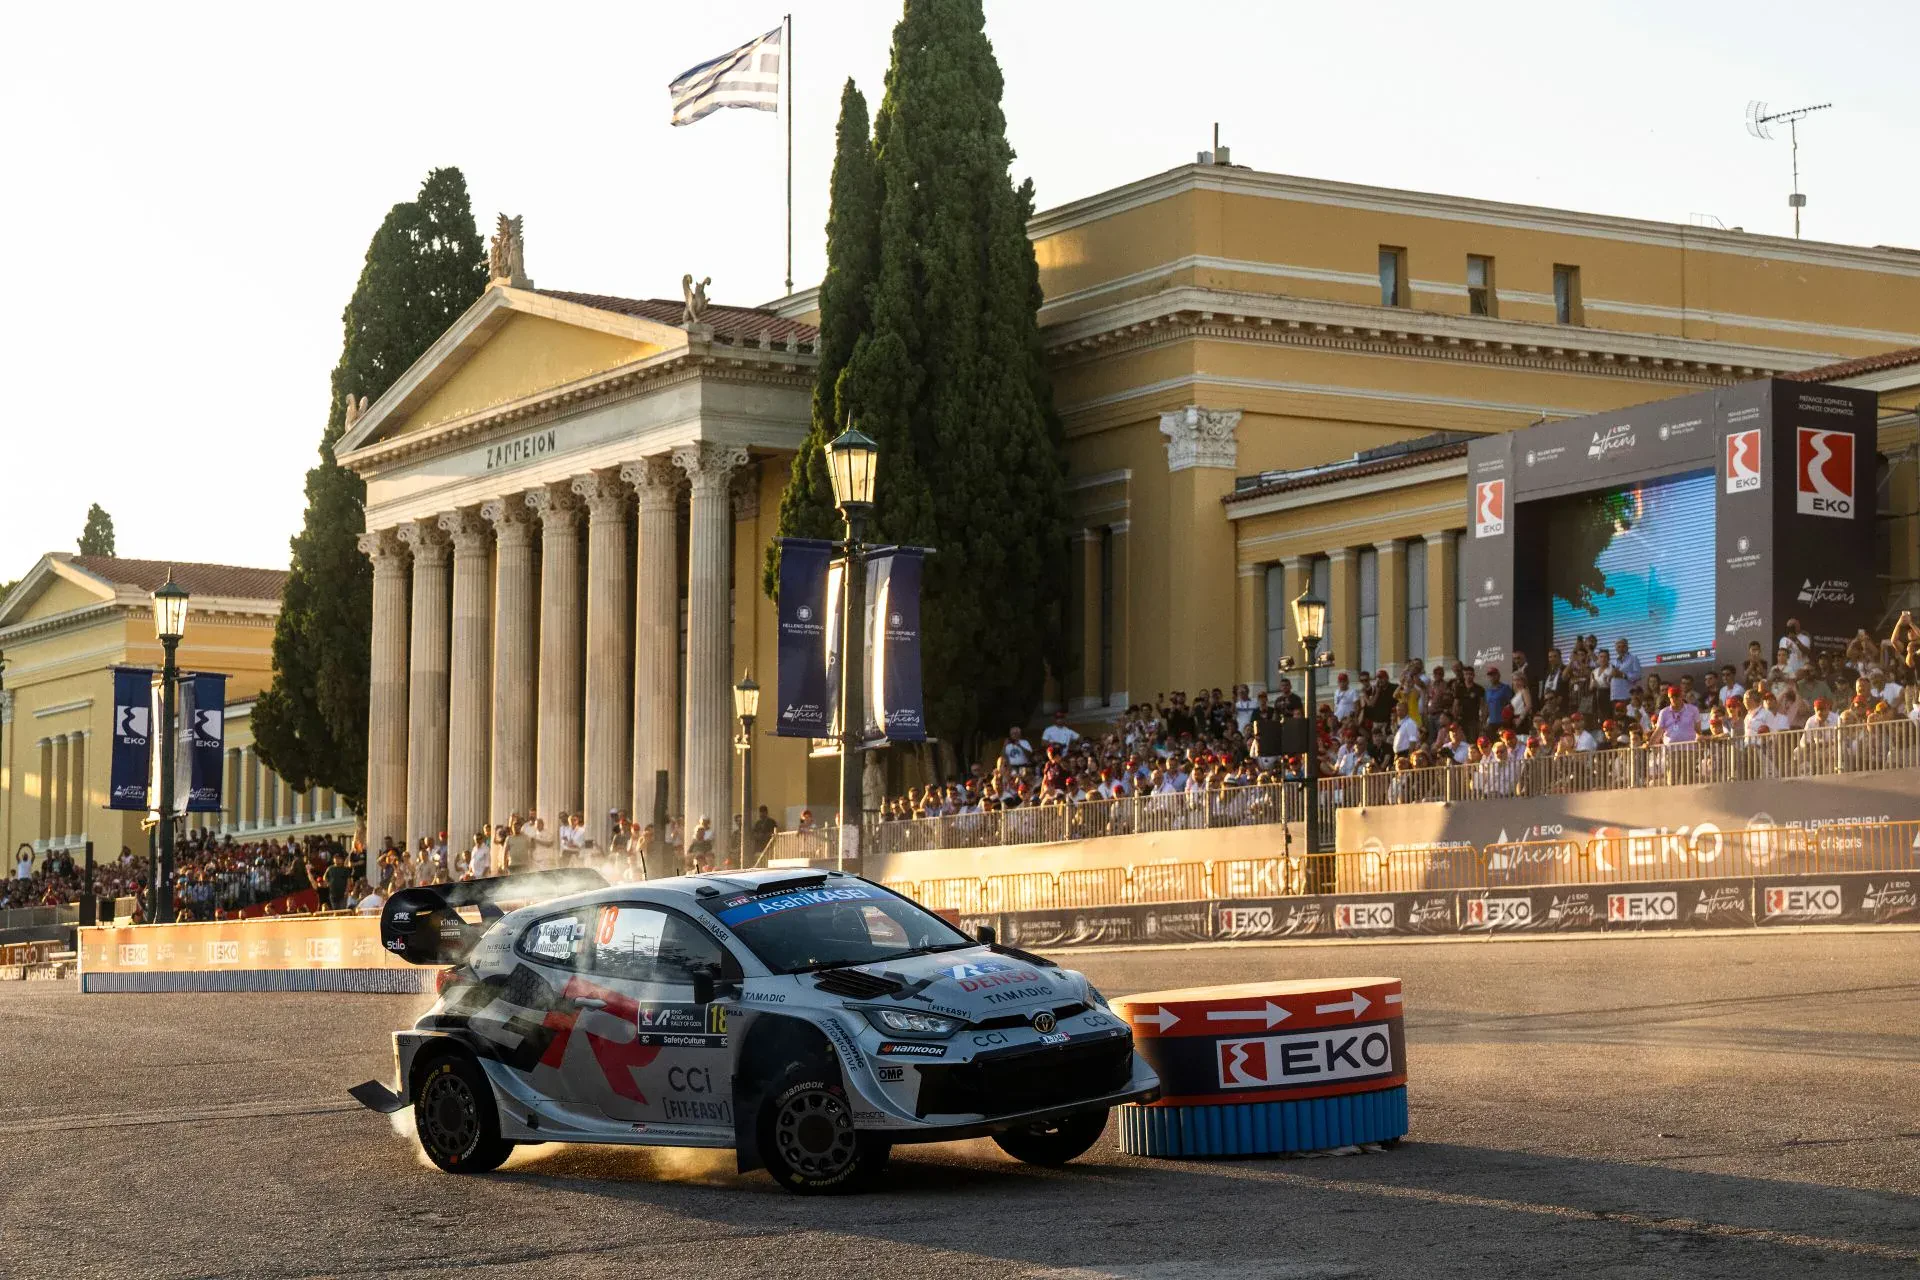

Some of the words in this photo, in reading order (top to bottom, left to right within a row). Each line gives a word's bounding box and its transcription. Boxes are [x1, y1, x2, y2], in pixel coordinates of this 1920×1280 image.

[1736, 477, 1758, 488] EKO
[1813, 498, 1850, 513] EKO
[1483, 523, 1501, 534] EKO
[123, 737, 146, 745] EKO
[196, 740, 220, 748] EKO
[1540, 825, 1563, 835] EKO
[1628, 823, 1723, 866] EKO
[750, 887, 794, 900] TOYOTA
[758, 888, 872, 913] AsahiKASEI
[1788, 890, 1839, 911] EKO
[1486, 902, 1530, 921] EKO
[1629, 896, 1676, 916] EKO
[594, 904, 619, 945] 18
[1236, 911, 1272, 928] EKO
[1354, 907, 1393, 925] EKO
[698, 914, 730, 942] AsahiKASEI
[387, 938, 406, 950] Stilo
[957, 971, 1039, 993] DENSO
[744, 991, 786, 1003] TAMADIC
[983, 986, 1053, 1004] TAMADIC
[711, 1005, 727, 1033] 18
[1083, 1013, 1112, 1027] CCI
[642, 1035, 650, 1043] SC
[663, 1036, 705, 1045] SafetyCulture
[817, 1020, 857, 1073] AUTOMOTIVE
[827, 1017, 864, 1069] Panasonic
[973, 1031, 1008, 1047] CCI
[1280, 1032, 1389, 1076] EKO
[880, 1068, 904, 1080] OMP
